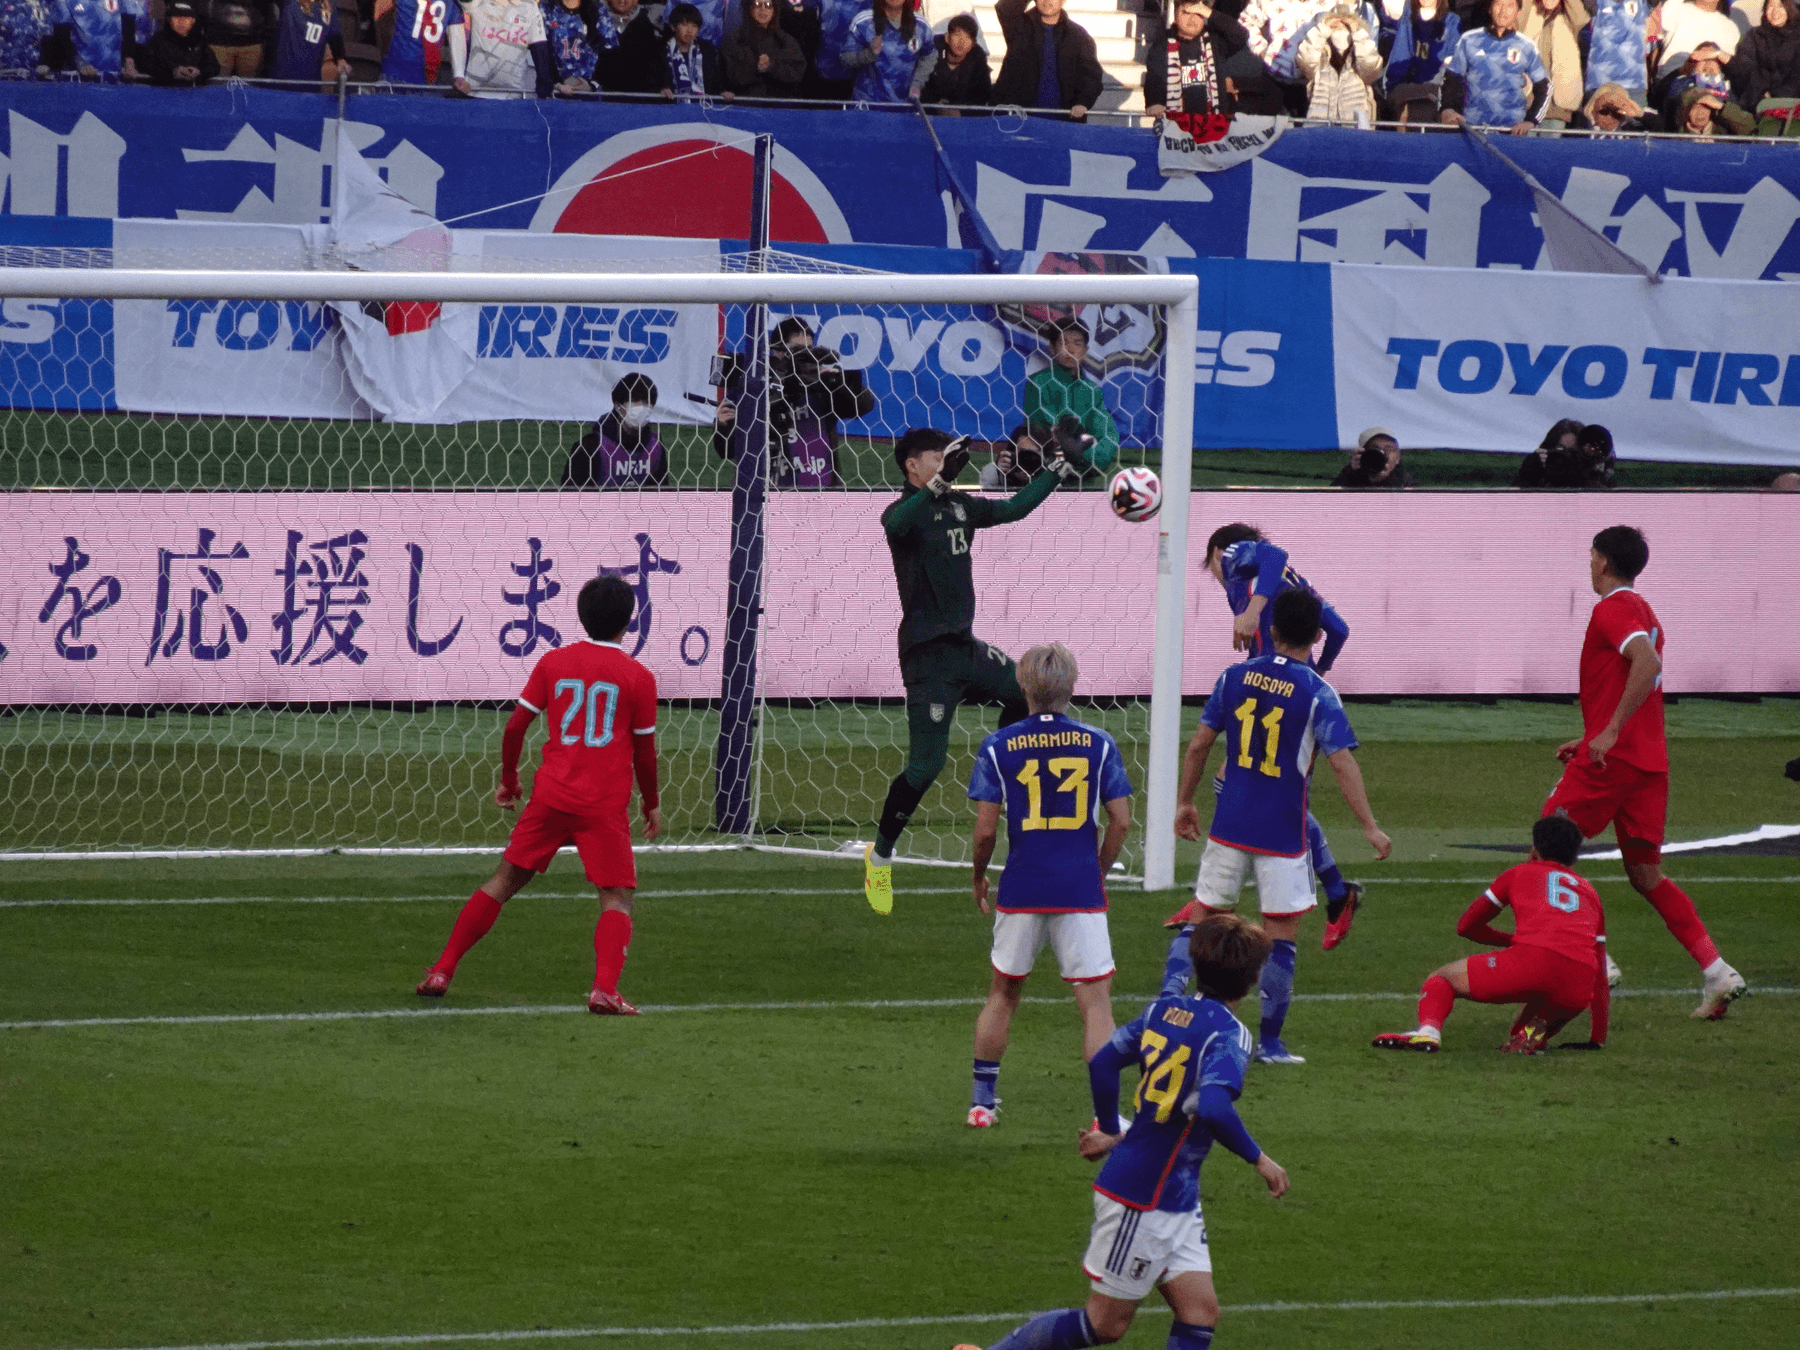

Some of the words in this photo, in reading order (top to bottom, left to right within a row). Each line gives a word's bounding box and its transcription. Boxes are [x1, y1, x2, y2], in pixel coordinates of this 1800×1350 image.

[305, 21, 323, 44] 10
[165, 300, 333, 351] TOY
[476, 305, 679, 364] IRES
[1386, 337, 1628, 400] TOYO
[947, 527, 968, 555] 23
[1242, 671, 1295, 698] HOSOYA
[554, 678, 619, 748] 20
[1234, 697, 1285, 778] 11
[1006, 731, 1092, 752] NAKAMURA
[1016, 757, 1089, 831] 13
[1548, 870, 1580, 913] 6
